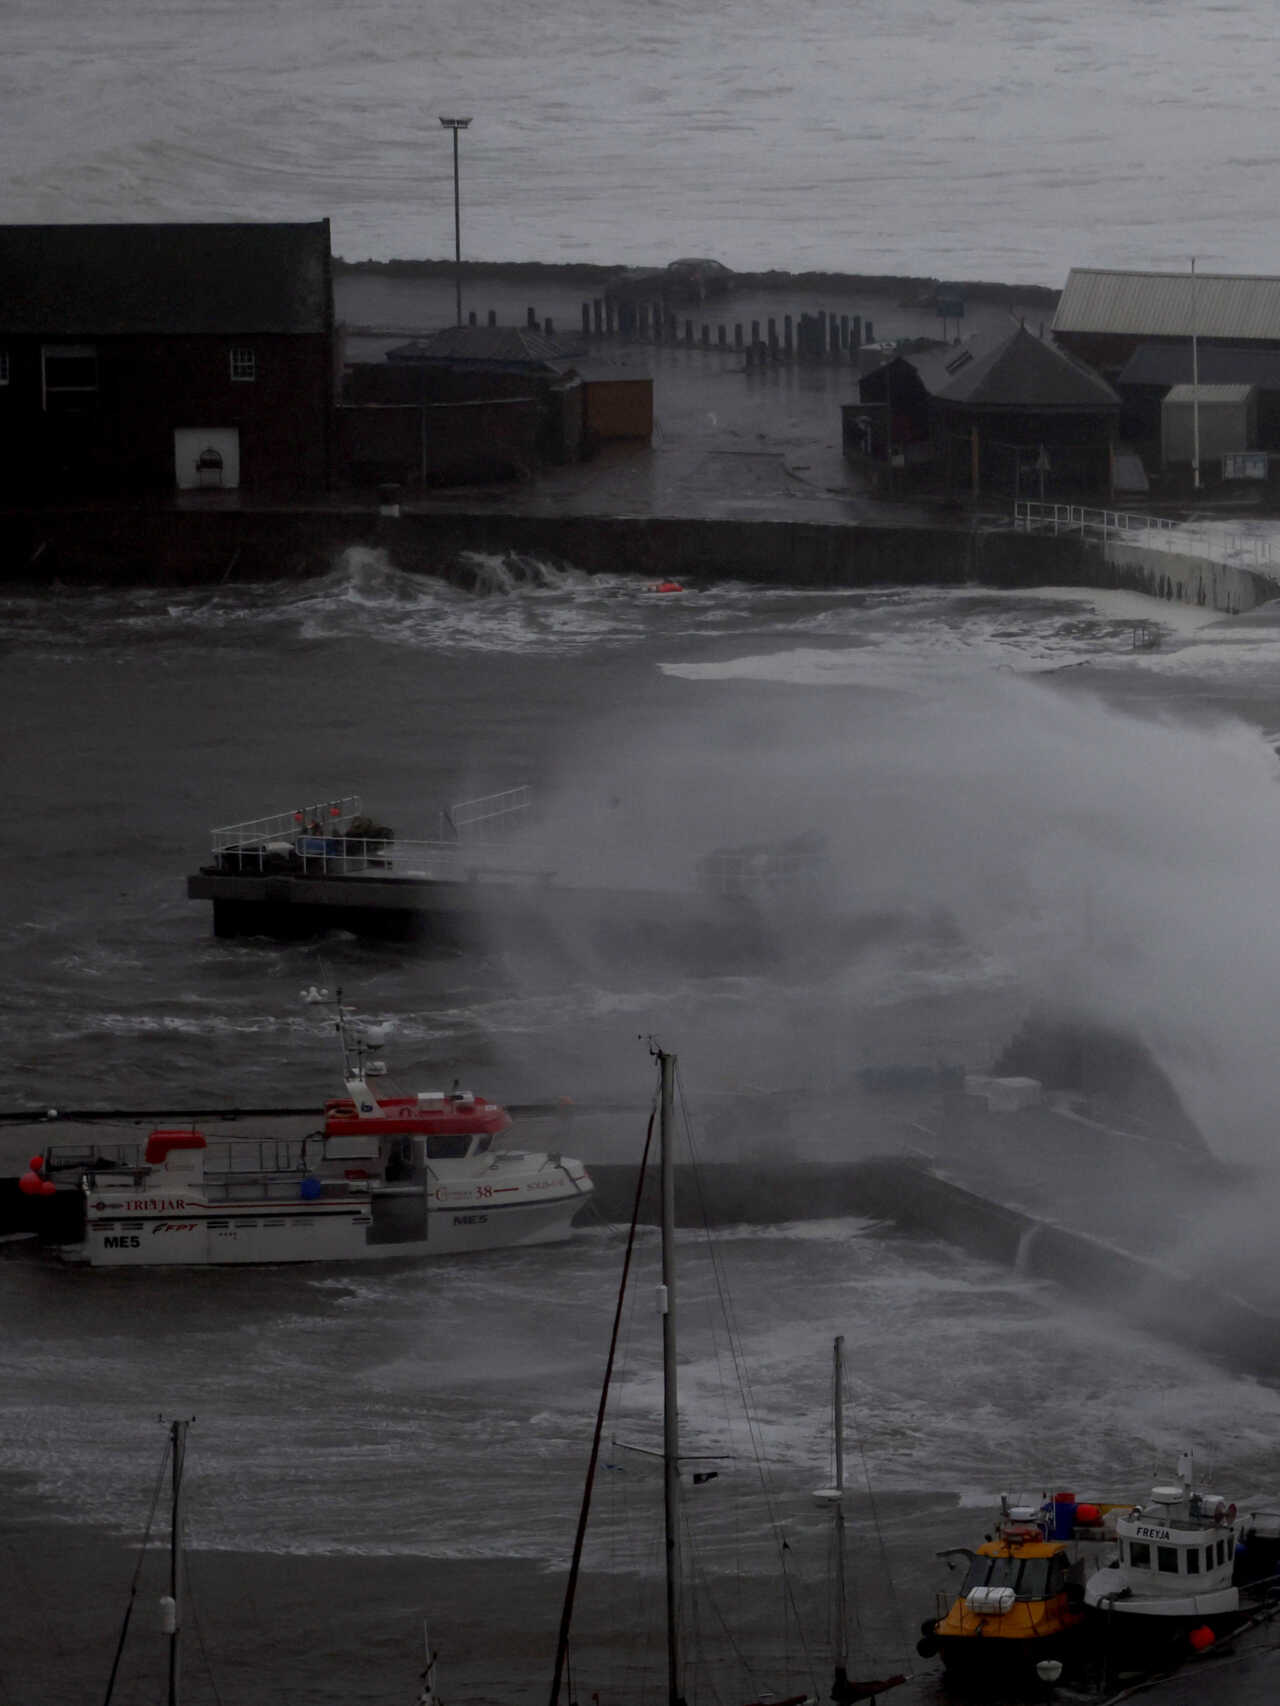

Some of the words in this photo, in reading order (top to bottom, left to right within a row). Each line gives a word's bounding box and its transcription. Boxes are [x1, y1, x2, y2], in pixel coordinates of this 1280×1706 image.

[453, 1214, 488, 1226] ME5
[104, 1236, 140, 1248] ME5
[1136, 1527, 1170, 1541] FREYJA
